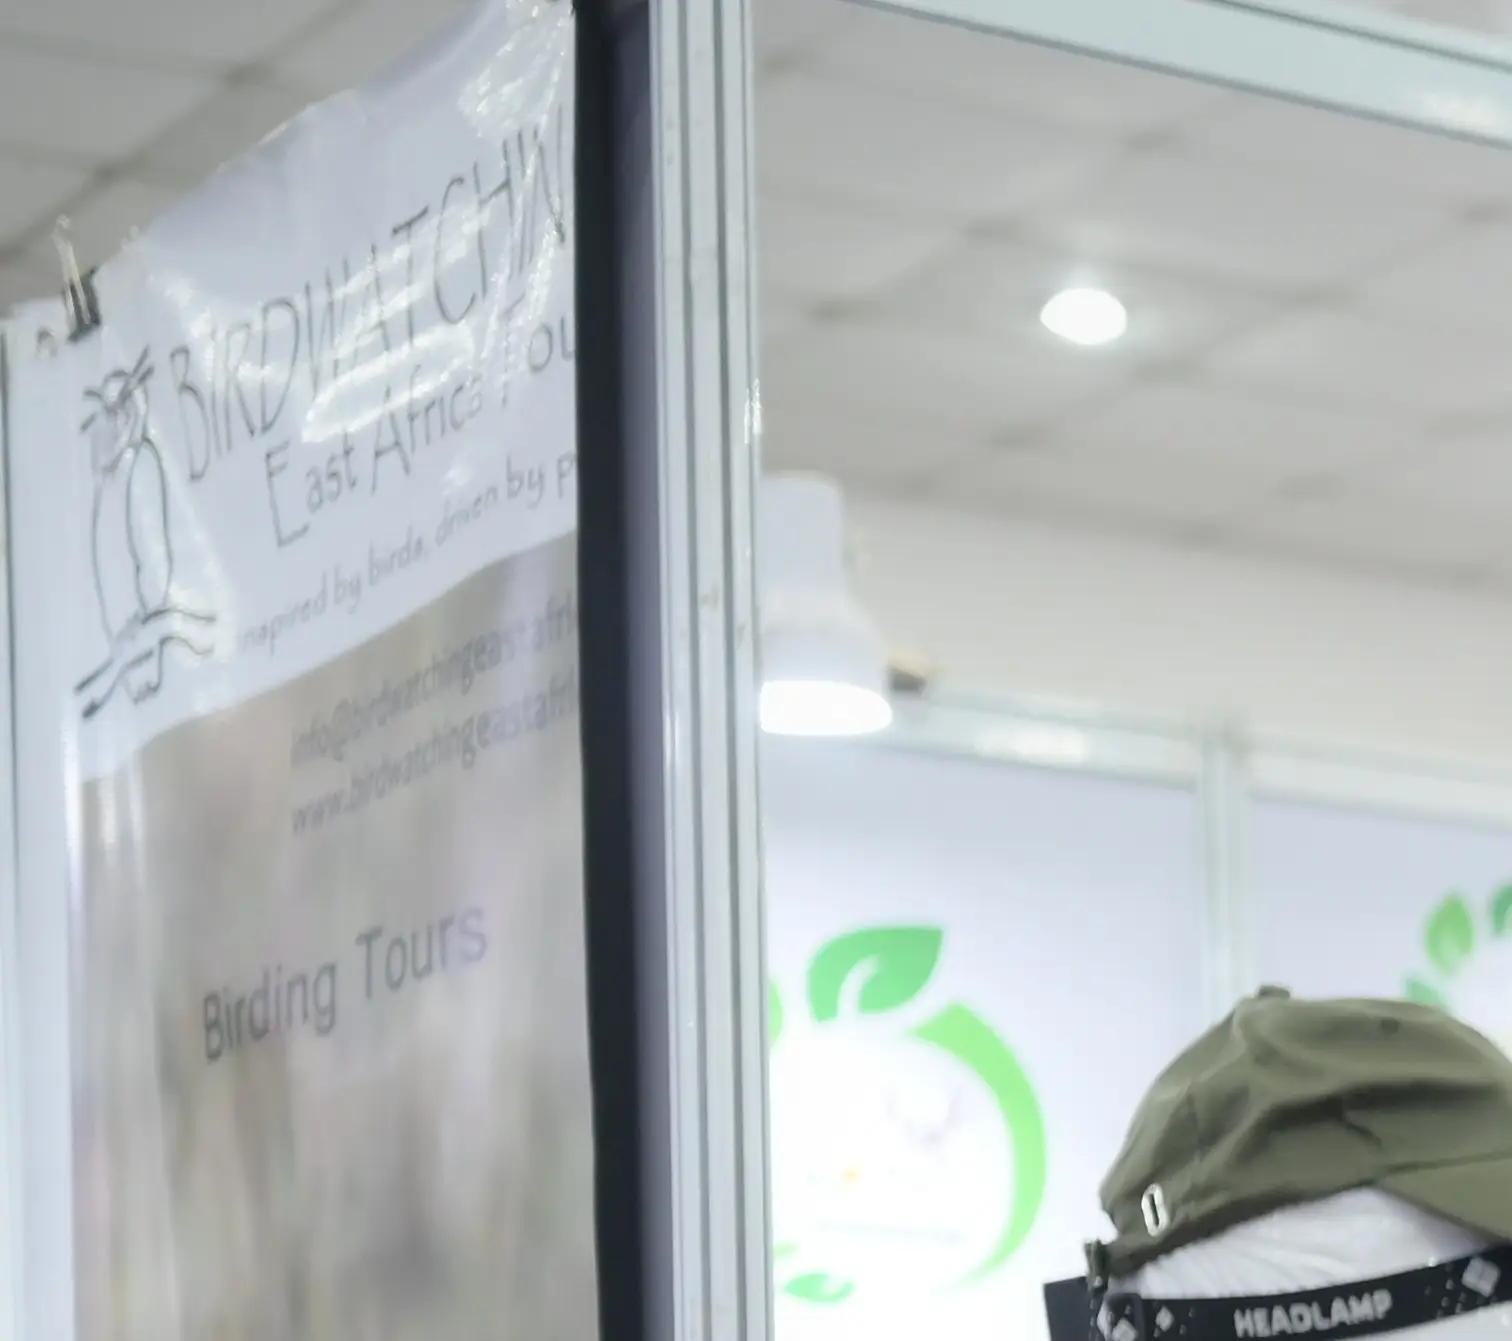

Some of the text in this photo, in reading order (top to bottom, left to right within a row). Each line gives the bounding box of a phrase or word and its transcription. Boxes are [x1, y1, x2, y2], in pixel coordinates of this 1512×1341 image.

[264, 426, 357, 548] East
[506, 453, 548, 511] by
[203, 907, 488, 1064] Birding Tours
[1233, 1289, 1392, 1338] HEADLAMP
